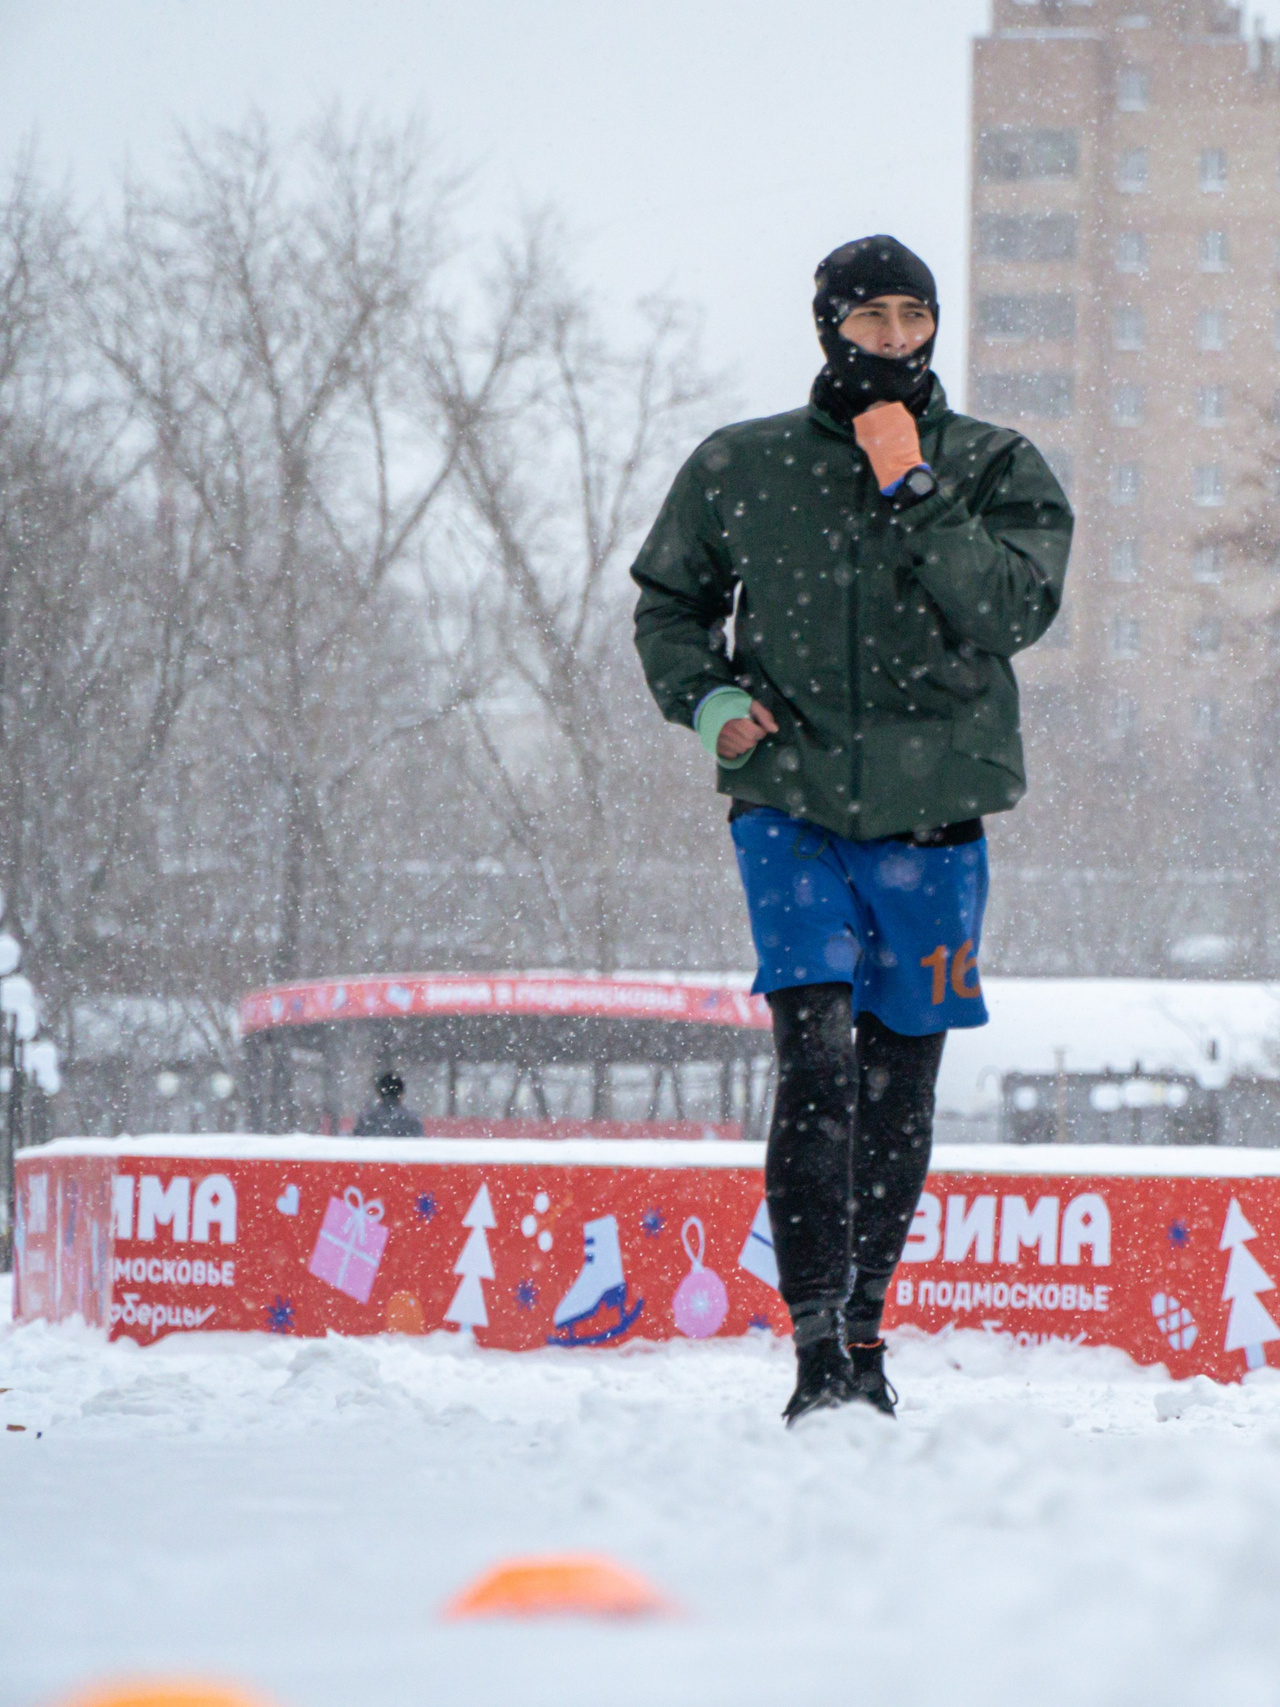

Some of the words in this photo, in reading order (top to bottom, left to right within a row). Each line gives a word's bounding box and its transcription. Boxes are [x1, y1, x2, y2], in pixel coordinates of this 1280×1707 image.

[920, 939, 982, 1006] 16
[109, 1174, 237, 1244] ИМА
[900, 1193, 1111, 1266] ЗИМА
[110, 1257, 235, 1287] МОСКОВЬЕ
[896, 1281, 914, 1306] В
[918, 1281, 1109, 1312] ПОДМОСКОВЬЕ
